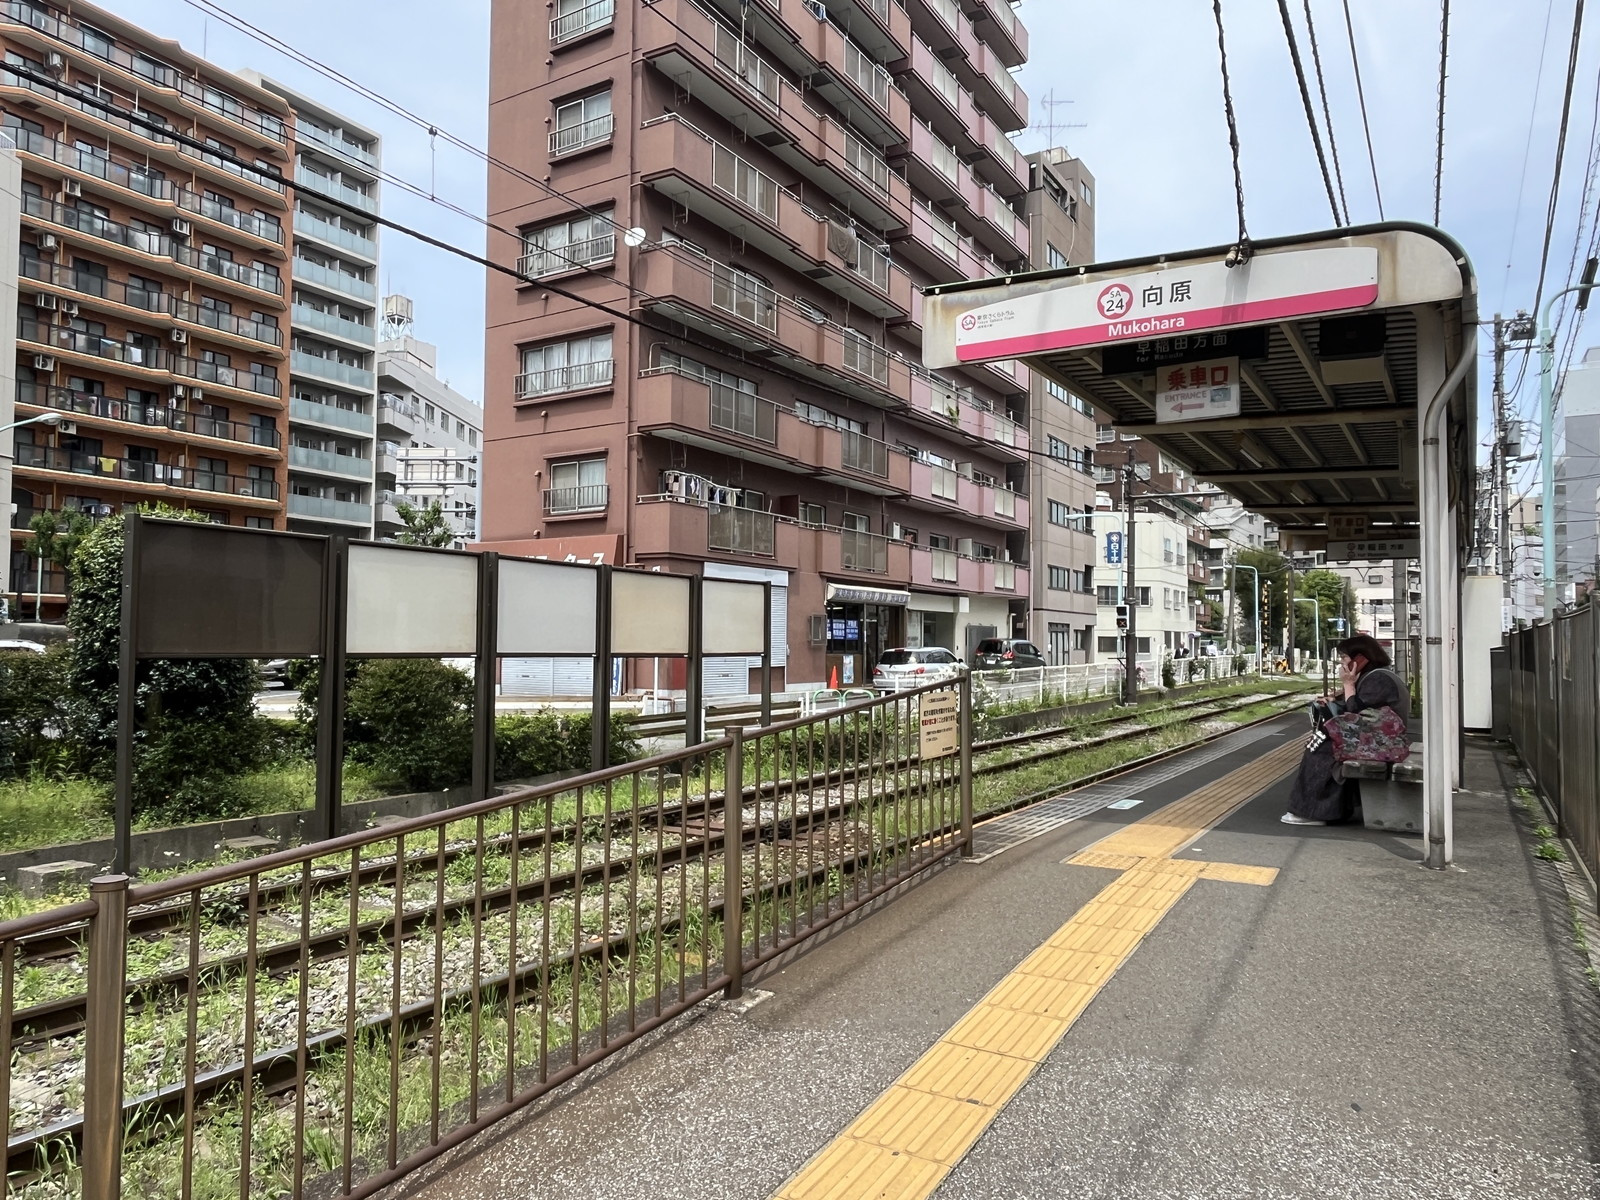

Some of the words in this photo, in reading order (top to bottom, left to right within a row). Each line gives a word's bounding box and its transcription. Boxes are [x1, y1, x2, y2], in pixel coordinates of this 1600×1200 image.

[1110, 290, 1122, 298] SA
[1142, 280, 1192, 308] 向原
[1106, 298, 1125, 312] 24
[964, 319, 973, 327] SA
[1108, 317, 1185, 336] Mukohara
[1136, 334, 1227, 355] 早稲田方面
[1167, 365, 1229, 390] 乗車口
[1164, 390, 1208, 403] ENTRANCE
